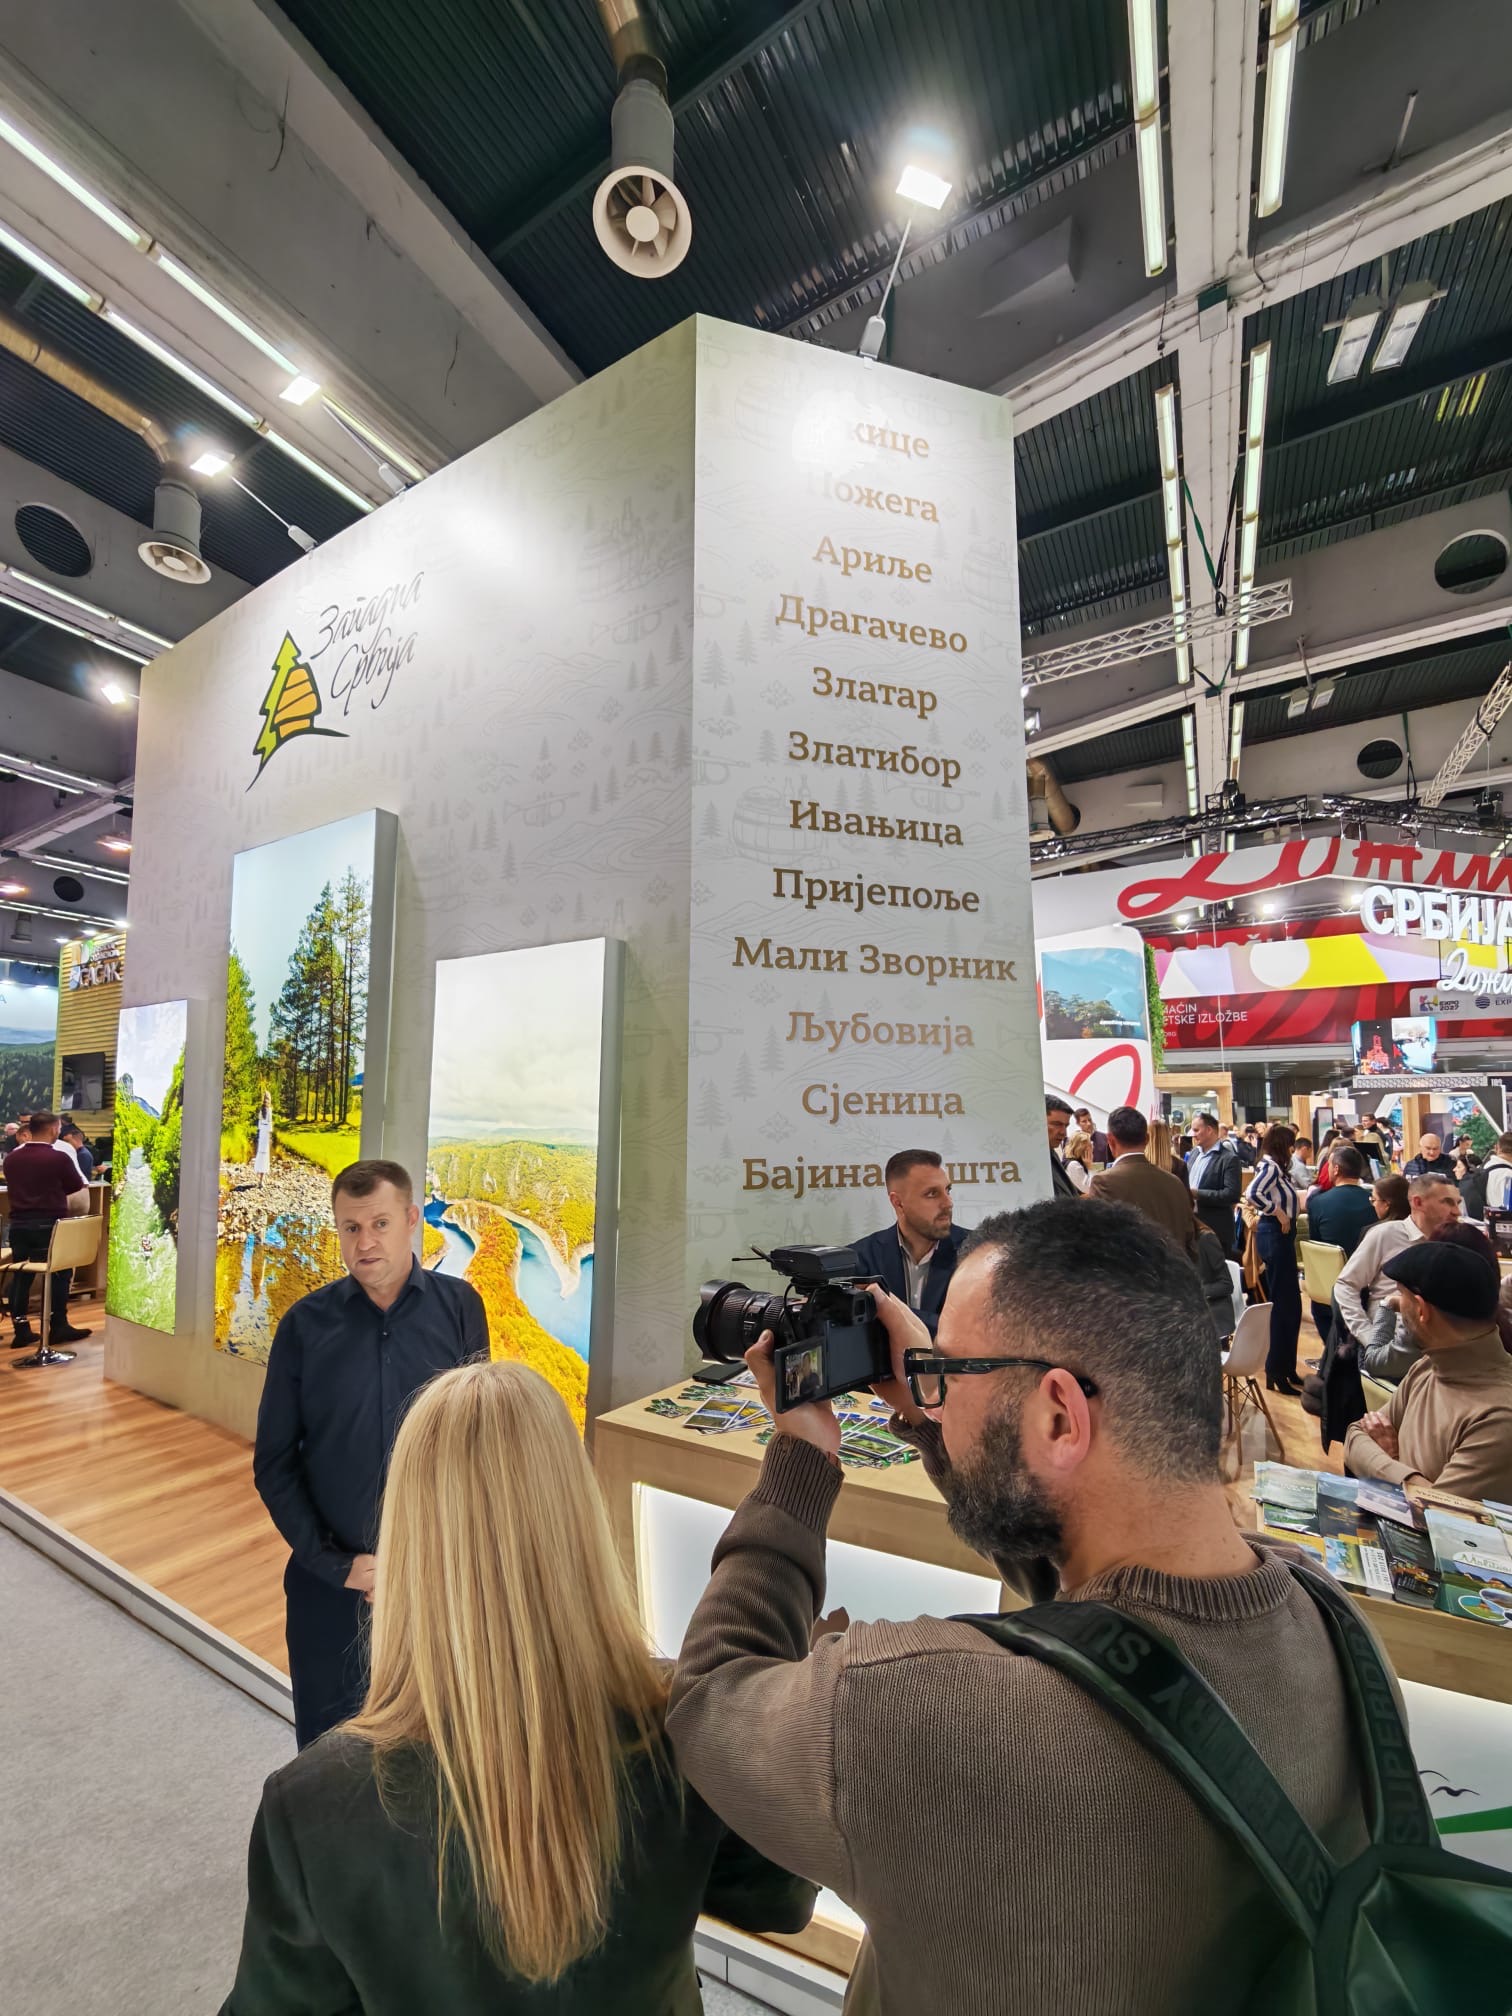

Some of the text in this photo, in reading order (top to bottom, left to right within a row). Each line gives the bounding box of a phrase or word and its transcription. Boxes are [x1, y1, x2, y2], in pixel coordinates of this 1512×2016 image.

[812, 536, 932, 582] Ариље
[776, 594, 968, 653] Драгачево
[812, 667, 937, 719] Златар
[788, 731, 961, 788] Златибор
[789, 799, 963, 847] Ивањица
[773, 867, 979, 912] Пријепоље
[1360, 885, 1512, 946] СРБИЈА
[732, 936, 1017, 986] Мали Зворник
[786, 1011, 974, 1055] Љубовија
[1198, 1010, 1248, 1024] IZLOŽBE
[801, 1083, 965, 1124] Сјеница
[742, 1157, 1022, 1198] Бајина шта
